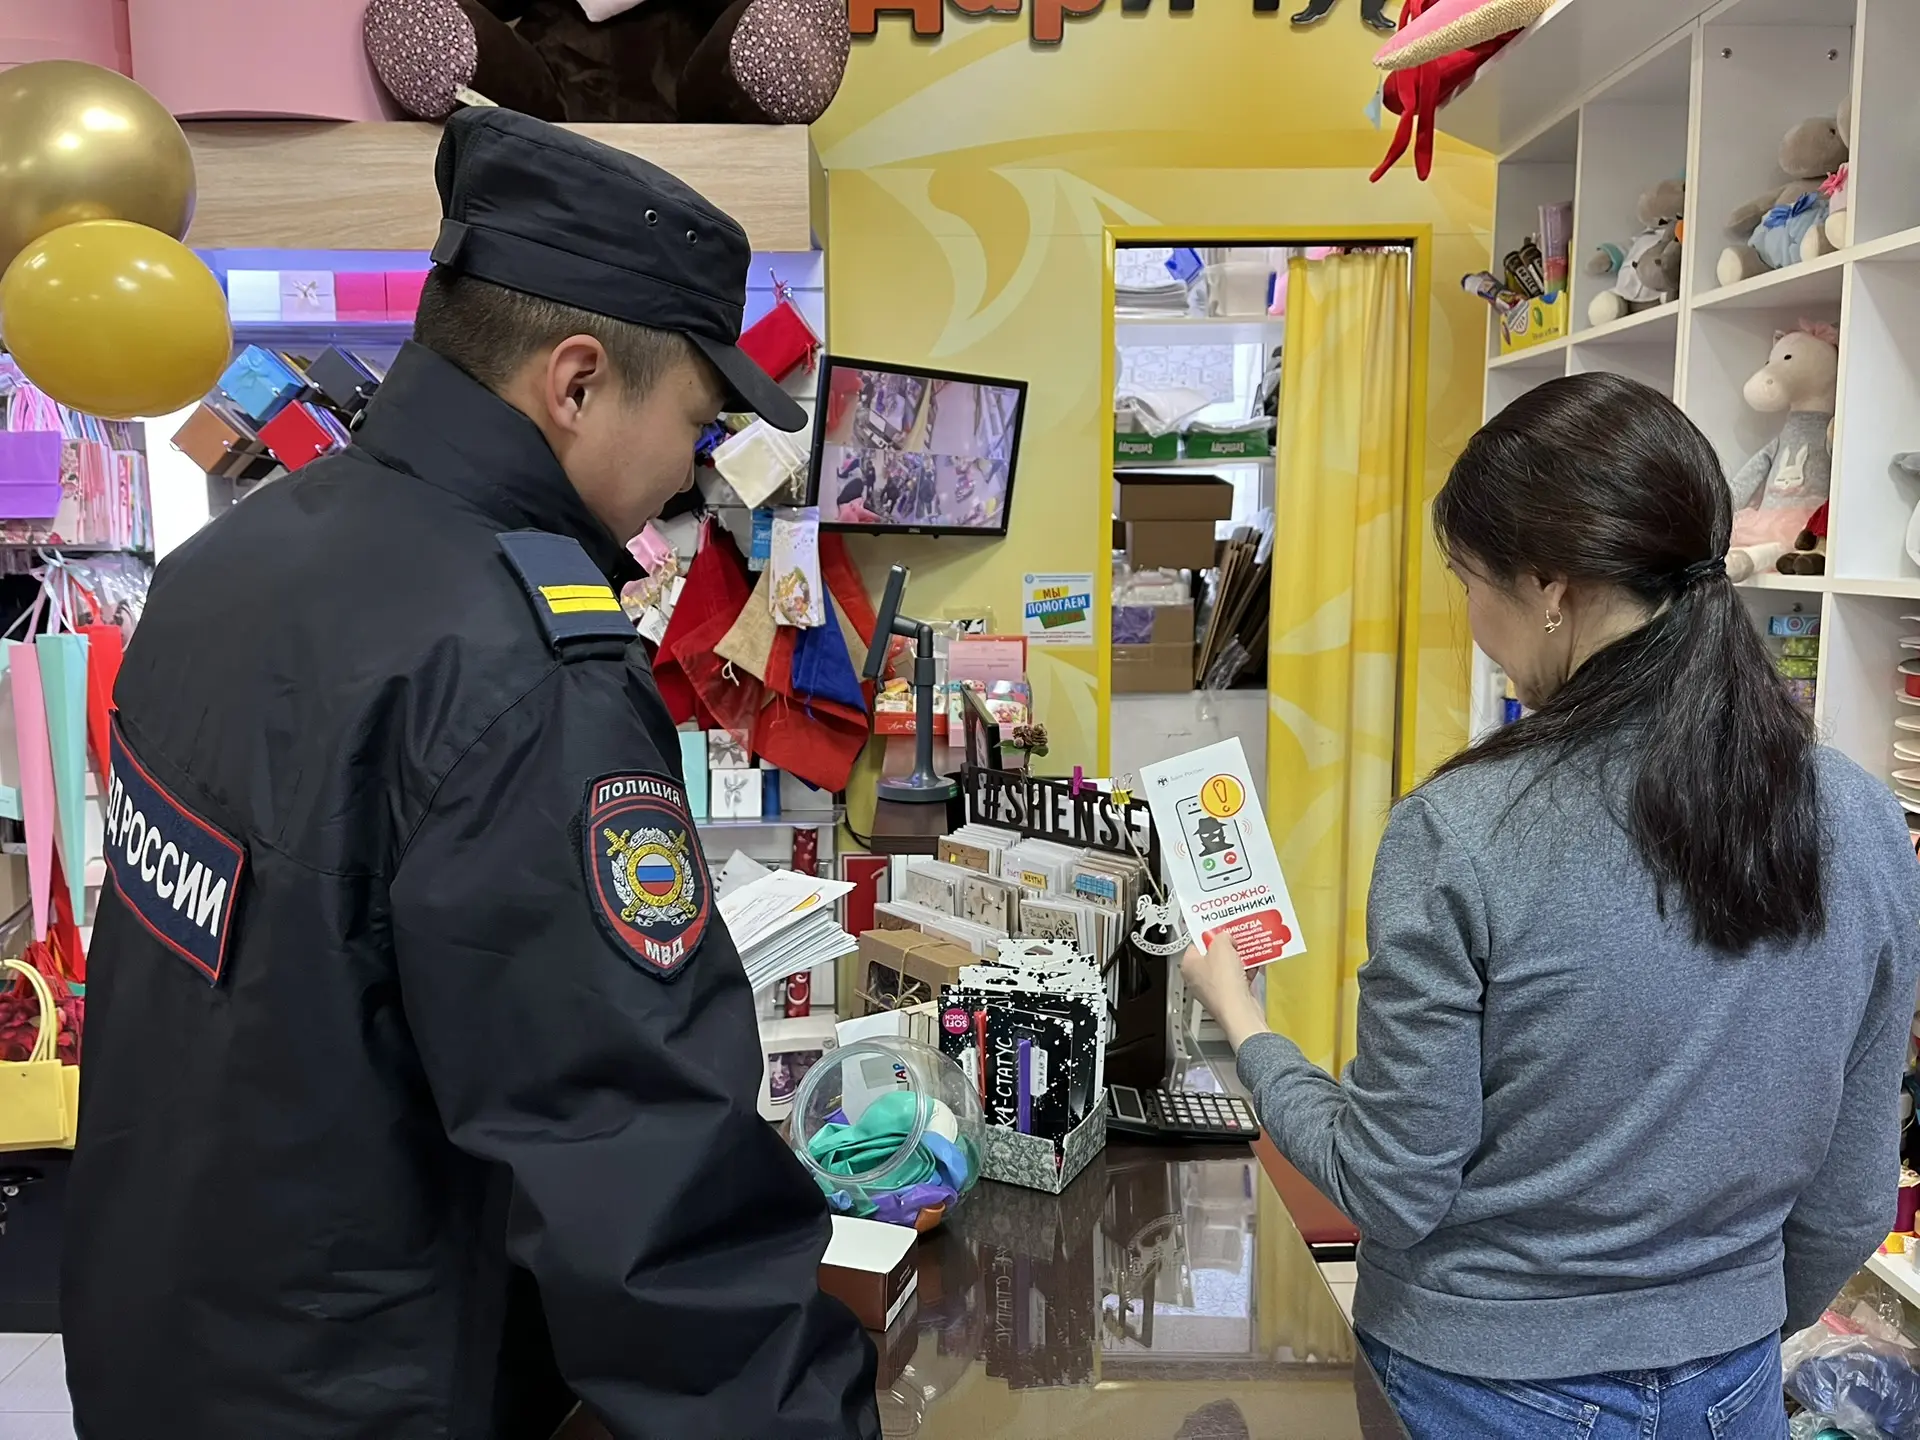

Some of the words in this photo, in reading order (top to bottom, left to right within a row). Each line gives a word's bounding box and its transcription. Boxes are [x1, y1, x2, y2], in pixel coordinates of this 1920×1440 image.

[1027, 596, 1087, 615] ПОМОГАЕМ
[1042, 587, 1061, 599] МЫ
[598, 779, 682, 808] ПОЛИЦИЯ
[118, 794, 228, 938] РОССИИ
[1191, 885, 1271, 913] ОСТОРОЖНО:
[1201, 894, 1277, 923] МОШЕННИКИ!
[644, 936, 684, 966] МВД
[945, 1019, 968, 1028] SOFT
[994, 1036, 1017, 1129] КА-СТАТУС
